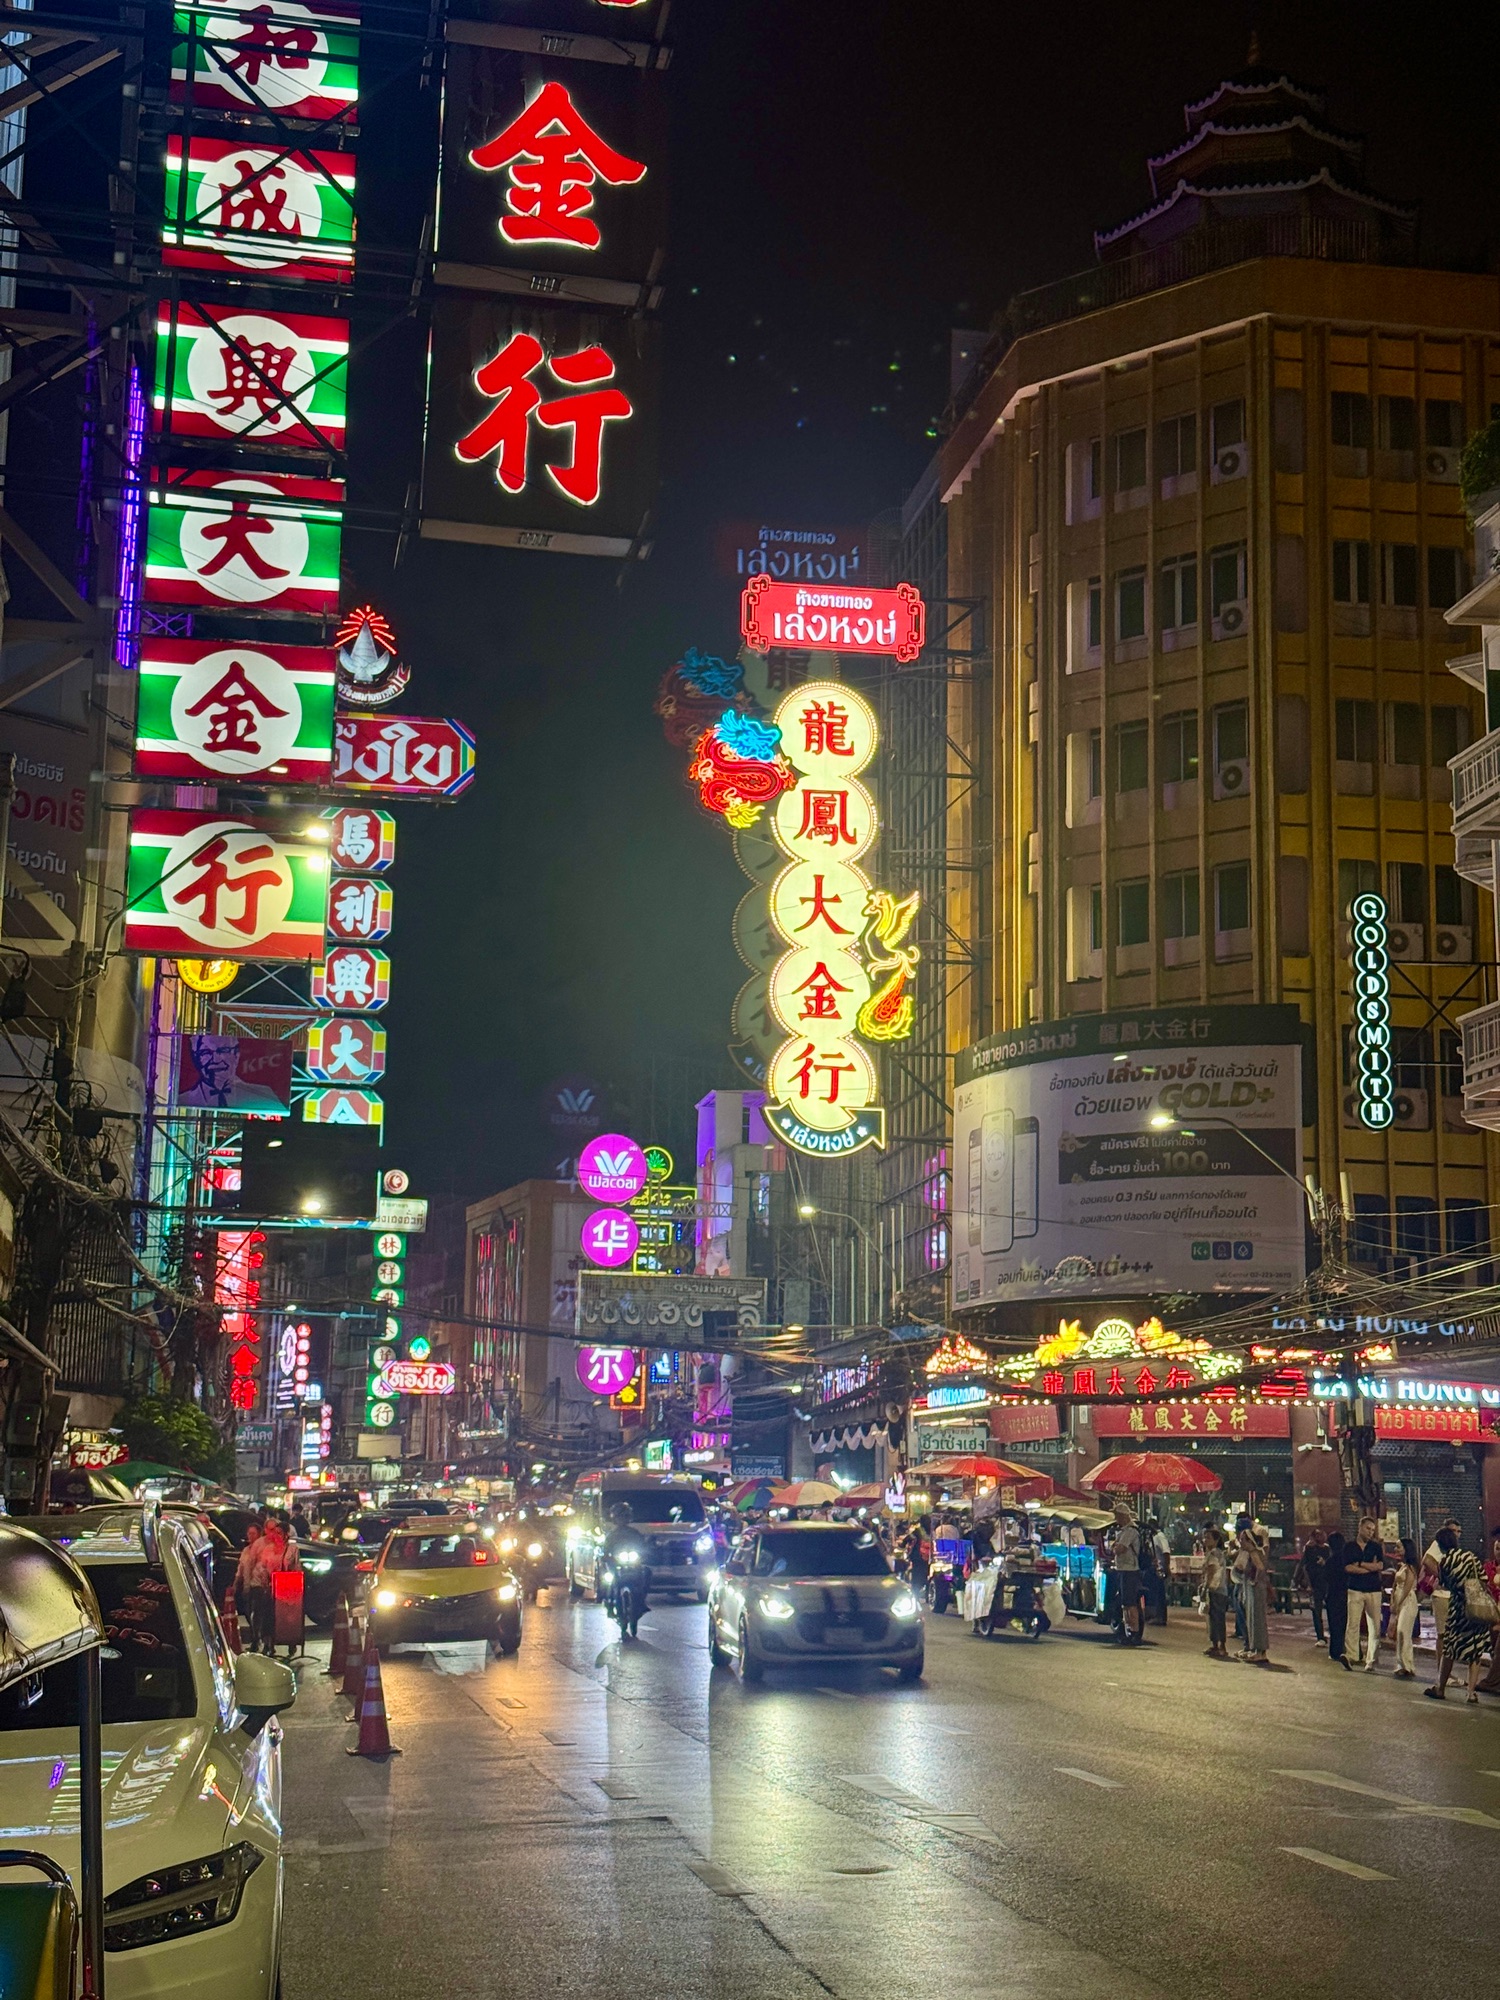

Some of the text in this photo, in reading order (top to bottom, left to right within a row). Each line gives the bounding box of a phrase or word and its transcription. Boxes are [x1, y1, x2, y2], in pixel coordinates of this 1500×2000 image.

[455, 0, 647, 502] 金行
[795, 589, 873, 610] ห้างขายทอง
[773, 606, 896, 646] เล่งหงษ์
[791, 700, 857, 1104] 龍鳳大金行
[1361, 900, 1384, 1122] GOLDSMITH
[1099, 1018, 1211, 1042] 龍鳳大金行
[242, 1053, 284, 1075] KFC
[1074, 1081, 1276, 1117] ด้วยแอพ GOLD+
[789, 1125, 855, 1151] เล่งหงษ์
[1163, 1151, 1209, 1172] 100
[1212, 1161, 1231, 1170] บาท
[588, 1174, 637, 1190] Wacoal
[389, 1367, 448, 1390] ทองใบ
[1043, 1367, 1195, 1396] 龍鳳大金行
[1127, 1407, 1248, 1432] 龍鳳大金行
